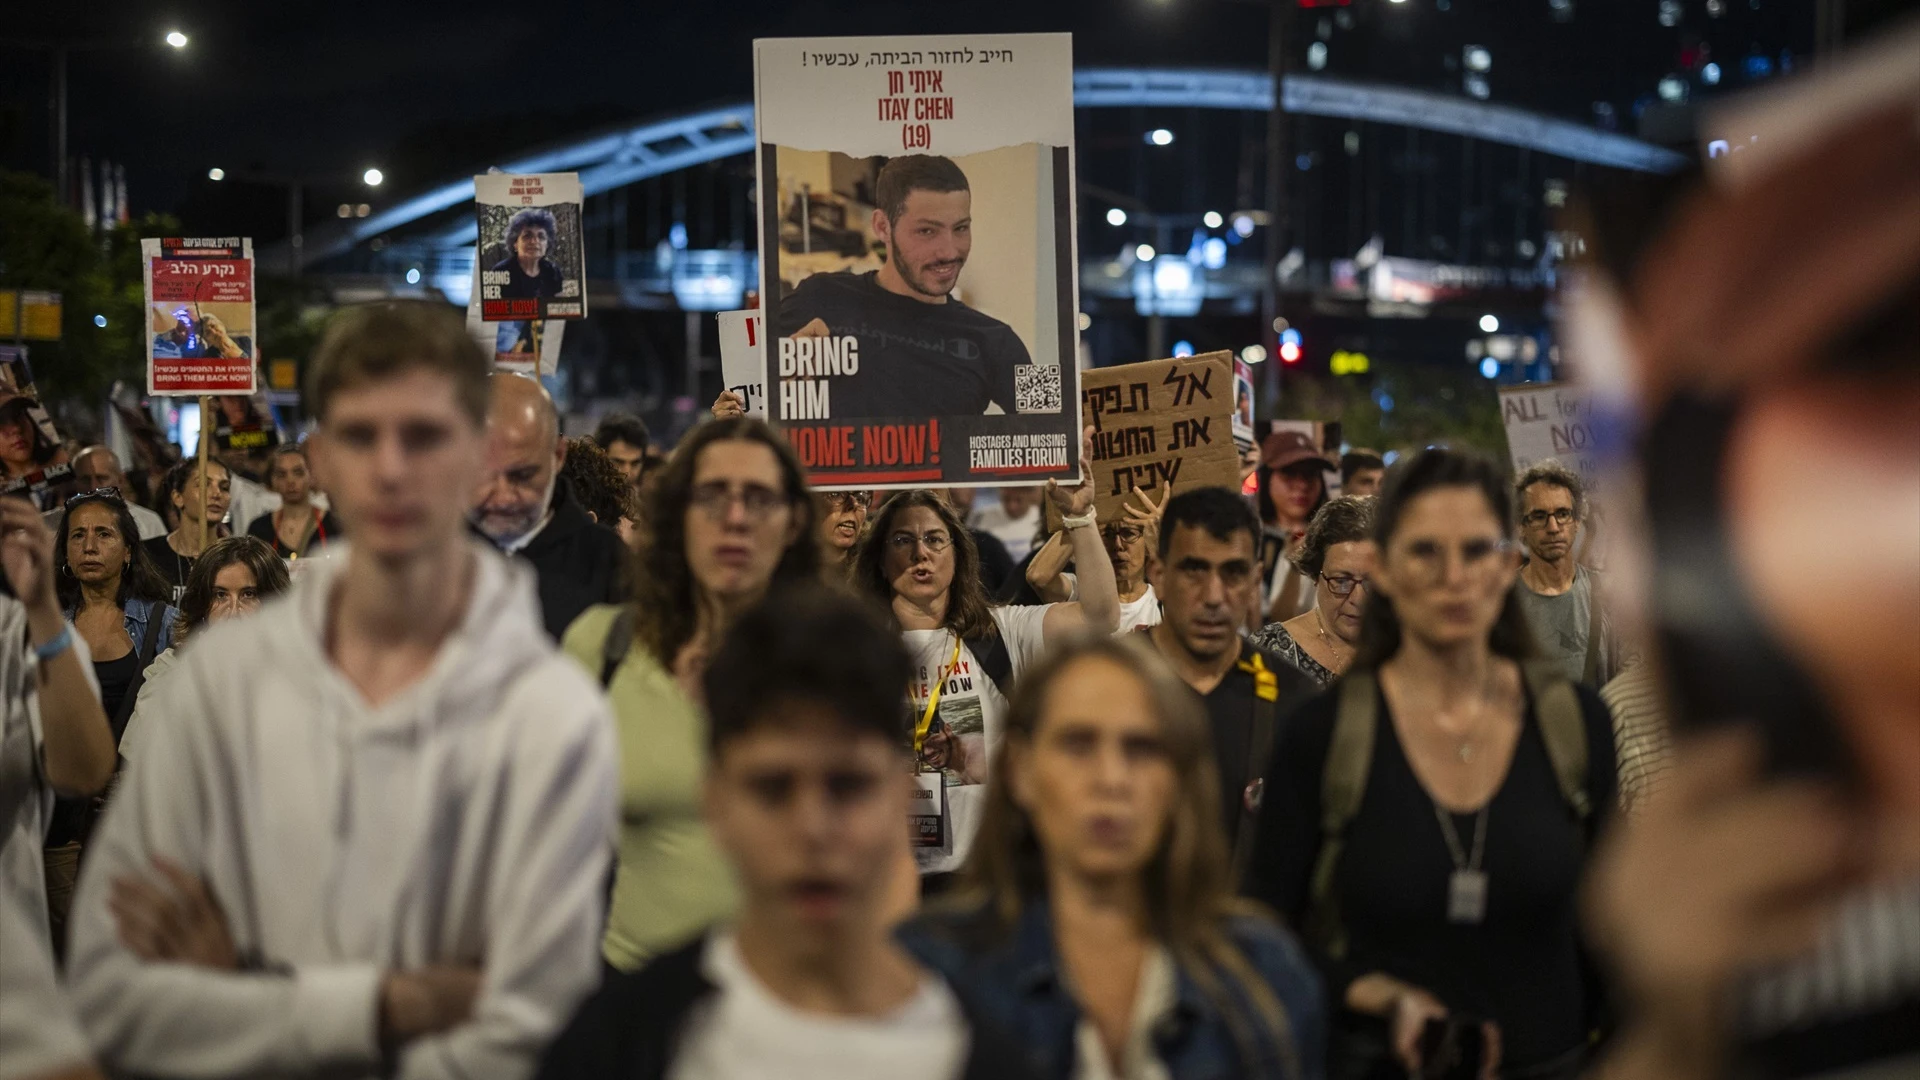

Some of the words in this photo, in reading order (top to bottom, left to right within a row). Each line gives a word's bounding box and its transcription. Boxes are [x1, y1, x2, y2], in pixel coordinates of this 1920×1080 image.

[811, 51, 859, 67] עכשיו
[864, 51, 923, 68] הביתה,
[927, 47, 974, 65] לחזור
[979, 49, 1014, 64] חייב
[887, 71, 904, 97] חן
[908, 70, 943, 93] איתי
[878, 98, 910, 122] ITAY
[914, 97, 954, 121] CHEN
[902, 123, 931, 150] (19)
[171, 261, 198, 275] הלב
[202, 263, 235, 278] נקרע
[482, 270, 510, 285] BRING
[483, 285, 502, 299] HER
[778, 335, 859, 377] BRING
[156, 374, 181, 382] BRING
[183, 374, 205, 382] THEM
[206, 374, 228, 382] BACK
[1162, 366, 1213, 407] אל
[779, 379, 830, 420] HIM
[1505, 396, 1548, 425] ALL
[862, 418, 941, 466] NOW!
[969, 434, 1011, 449] HOSTAGES
[1012, 434, 1029, 448] AND
[1030, 433, 1067, 447] MISSING
[1167, 416, 1213, 451] את
[970, 448, 1023, 469] FAMILIES
[1025, 447, 1068, 467] FORUM
[1111, 456, 1183, 497] שנית
